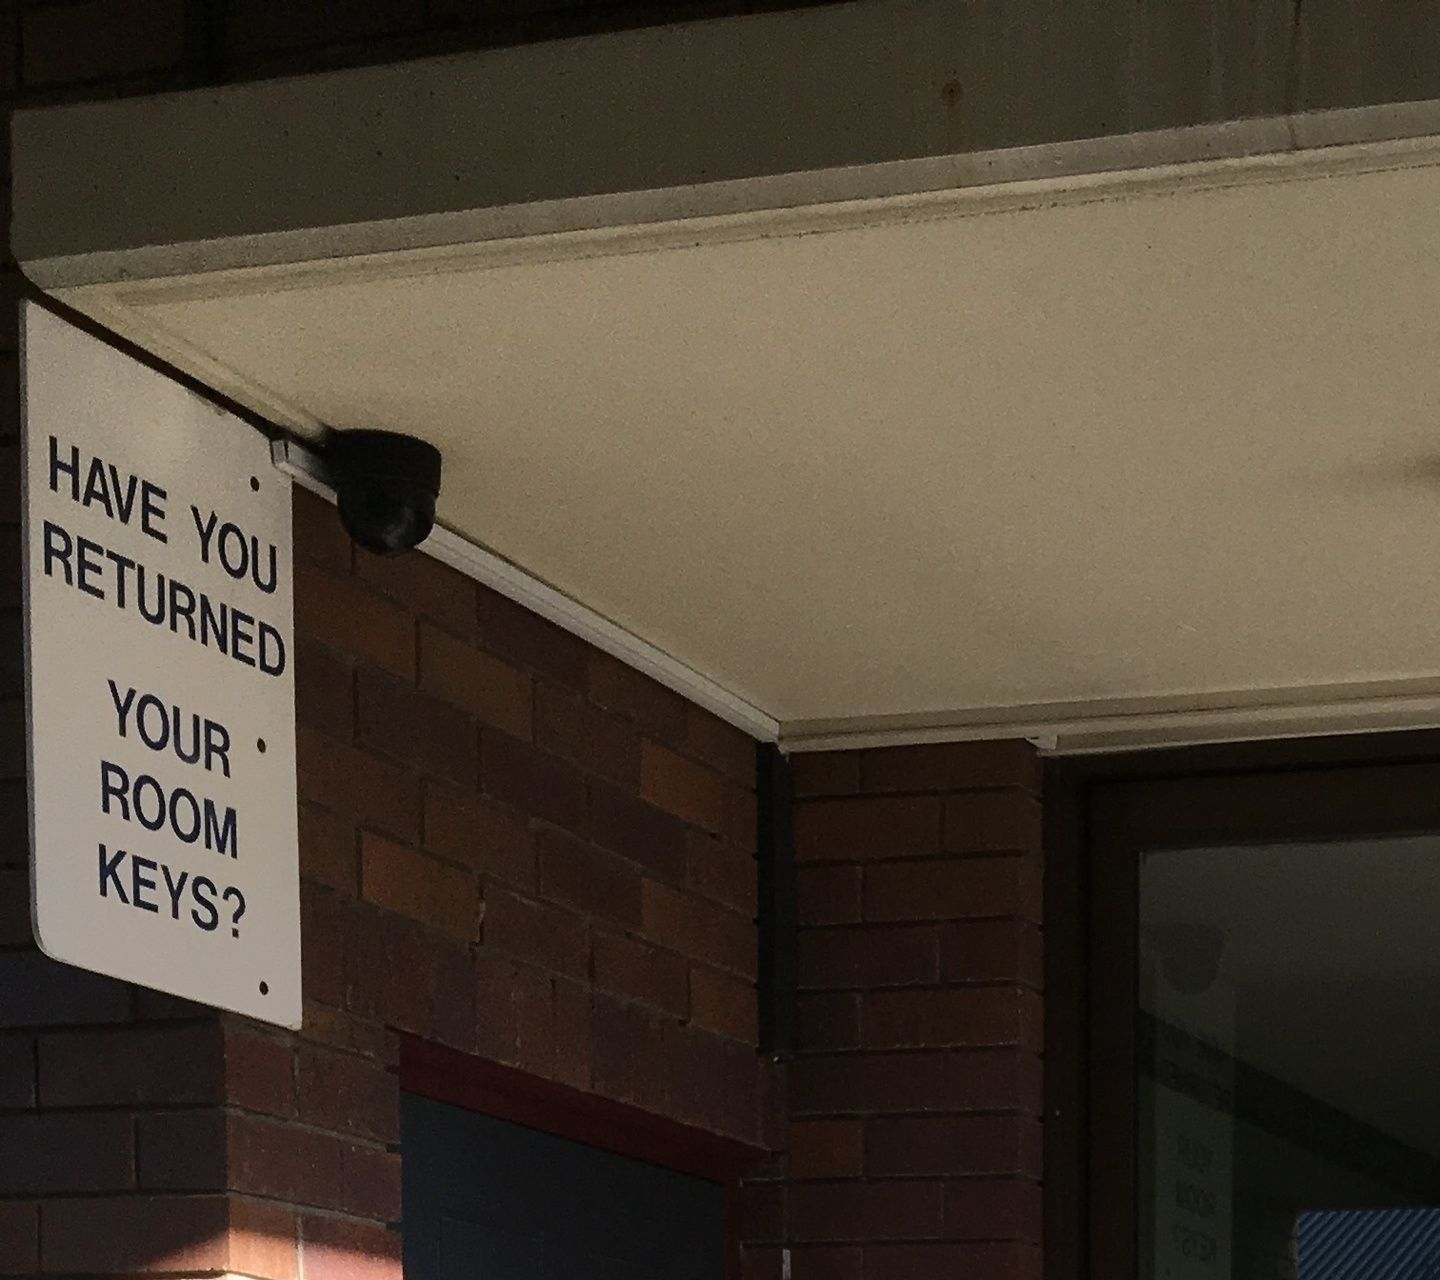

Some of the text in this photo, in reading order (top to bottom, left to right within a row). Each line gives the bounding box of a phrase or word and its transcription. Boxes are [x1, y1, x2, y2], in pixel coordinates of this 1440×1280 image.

[48, 435, 277, 594] HAVE YOU
[43, 519, 286, 677] RETURNED
[107, 679, 231, 778] YOUR
[101, 761, 238, 859] ROOM
[99, 843, 246, 938] KEYS?
